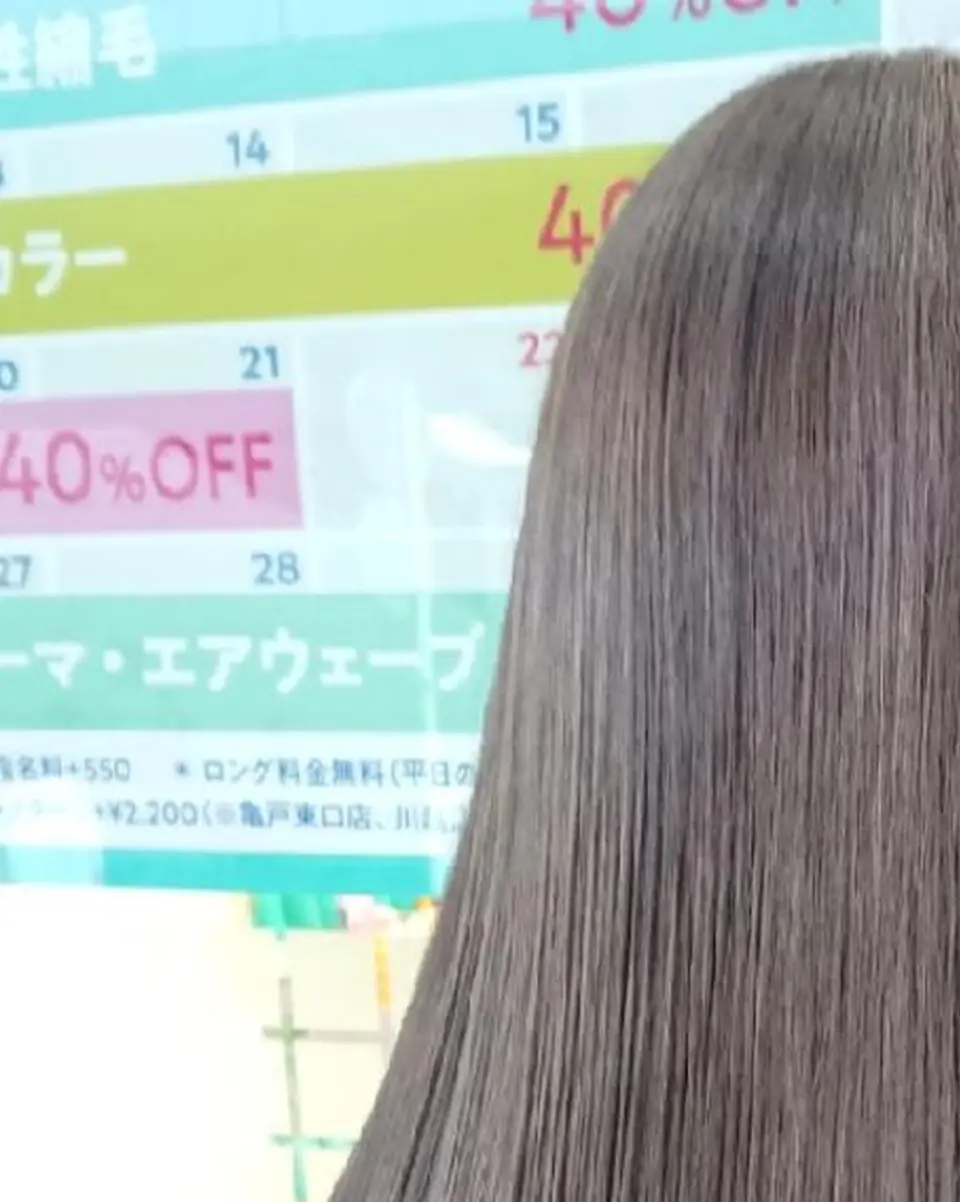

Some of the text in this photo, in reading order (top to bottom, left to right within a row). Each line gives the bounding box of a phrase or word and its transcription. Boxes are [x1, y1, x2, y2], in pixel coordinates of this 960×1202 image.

[516, 102, 561, 143] 15
[225, 128, 269, 169] 14
[0, 229, 127, 298] ラー
[239, 344, 280, 381] 21
[0, 429, 274, 506] 40%OFF
[251, 551, 300, 586] 28
